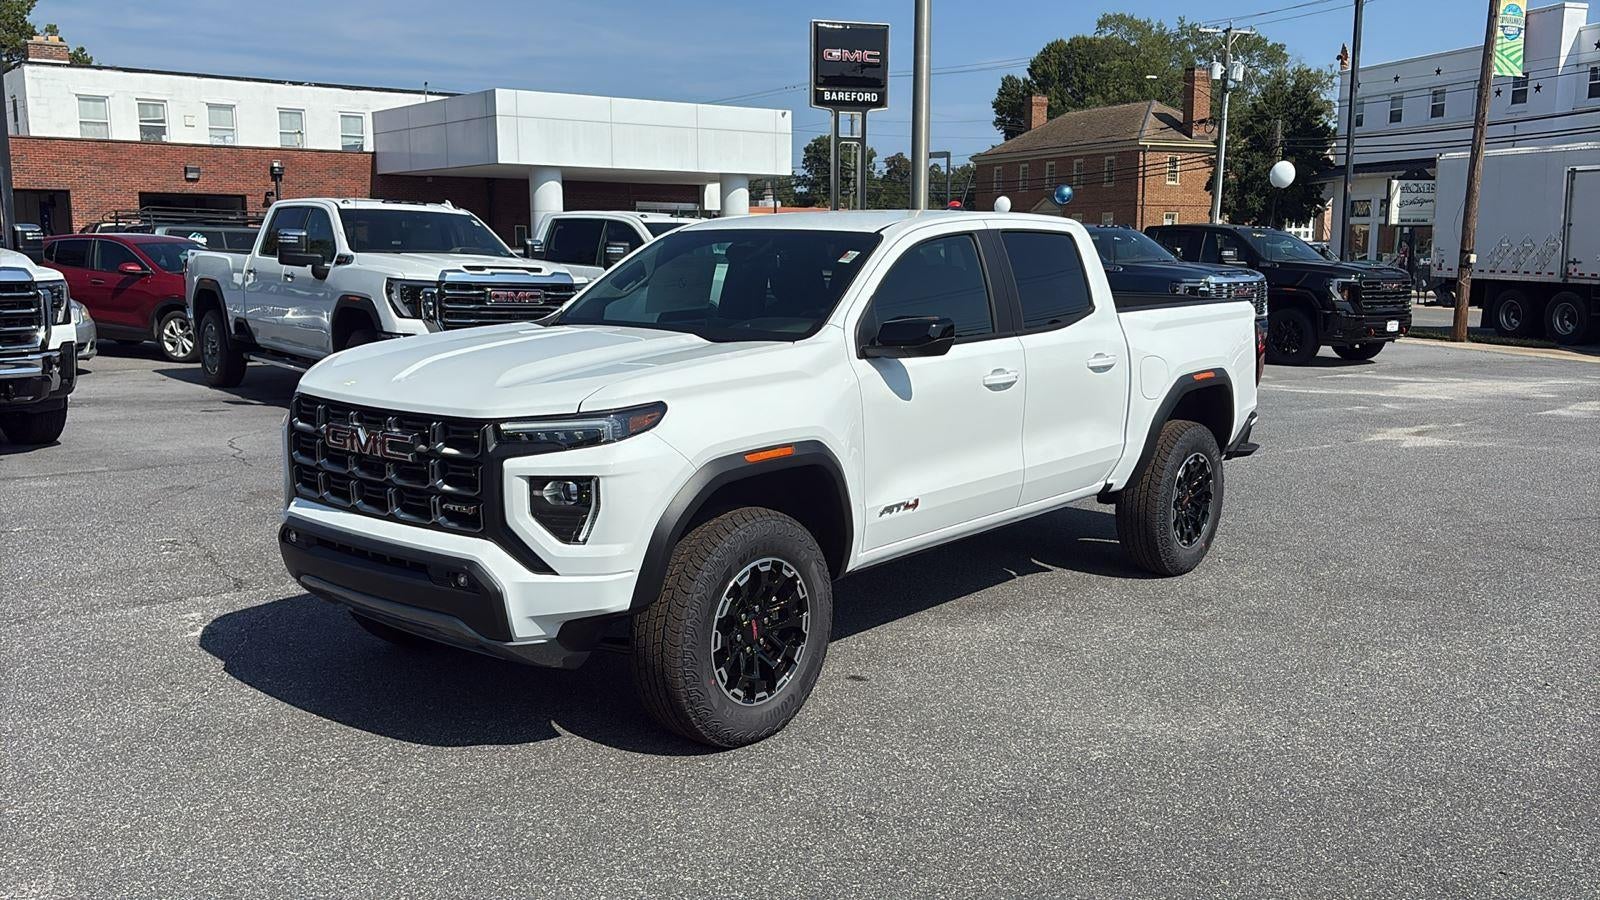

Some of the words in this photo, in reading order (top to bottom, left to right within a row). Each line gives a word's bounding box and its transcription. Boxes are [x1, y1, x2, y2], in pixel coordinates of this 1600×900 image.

[823, 48, 880, 63] GMC
[824, 91, 878, 102] BAREFORD
[490, 291, 541, 303] GMC
[324, 422, 416, 462] GMC
[878, 498, 919, 517] AT4
